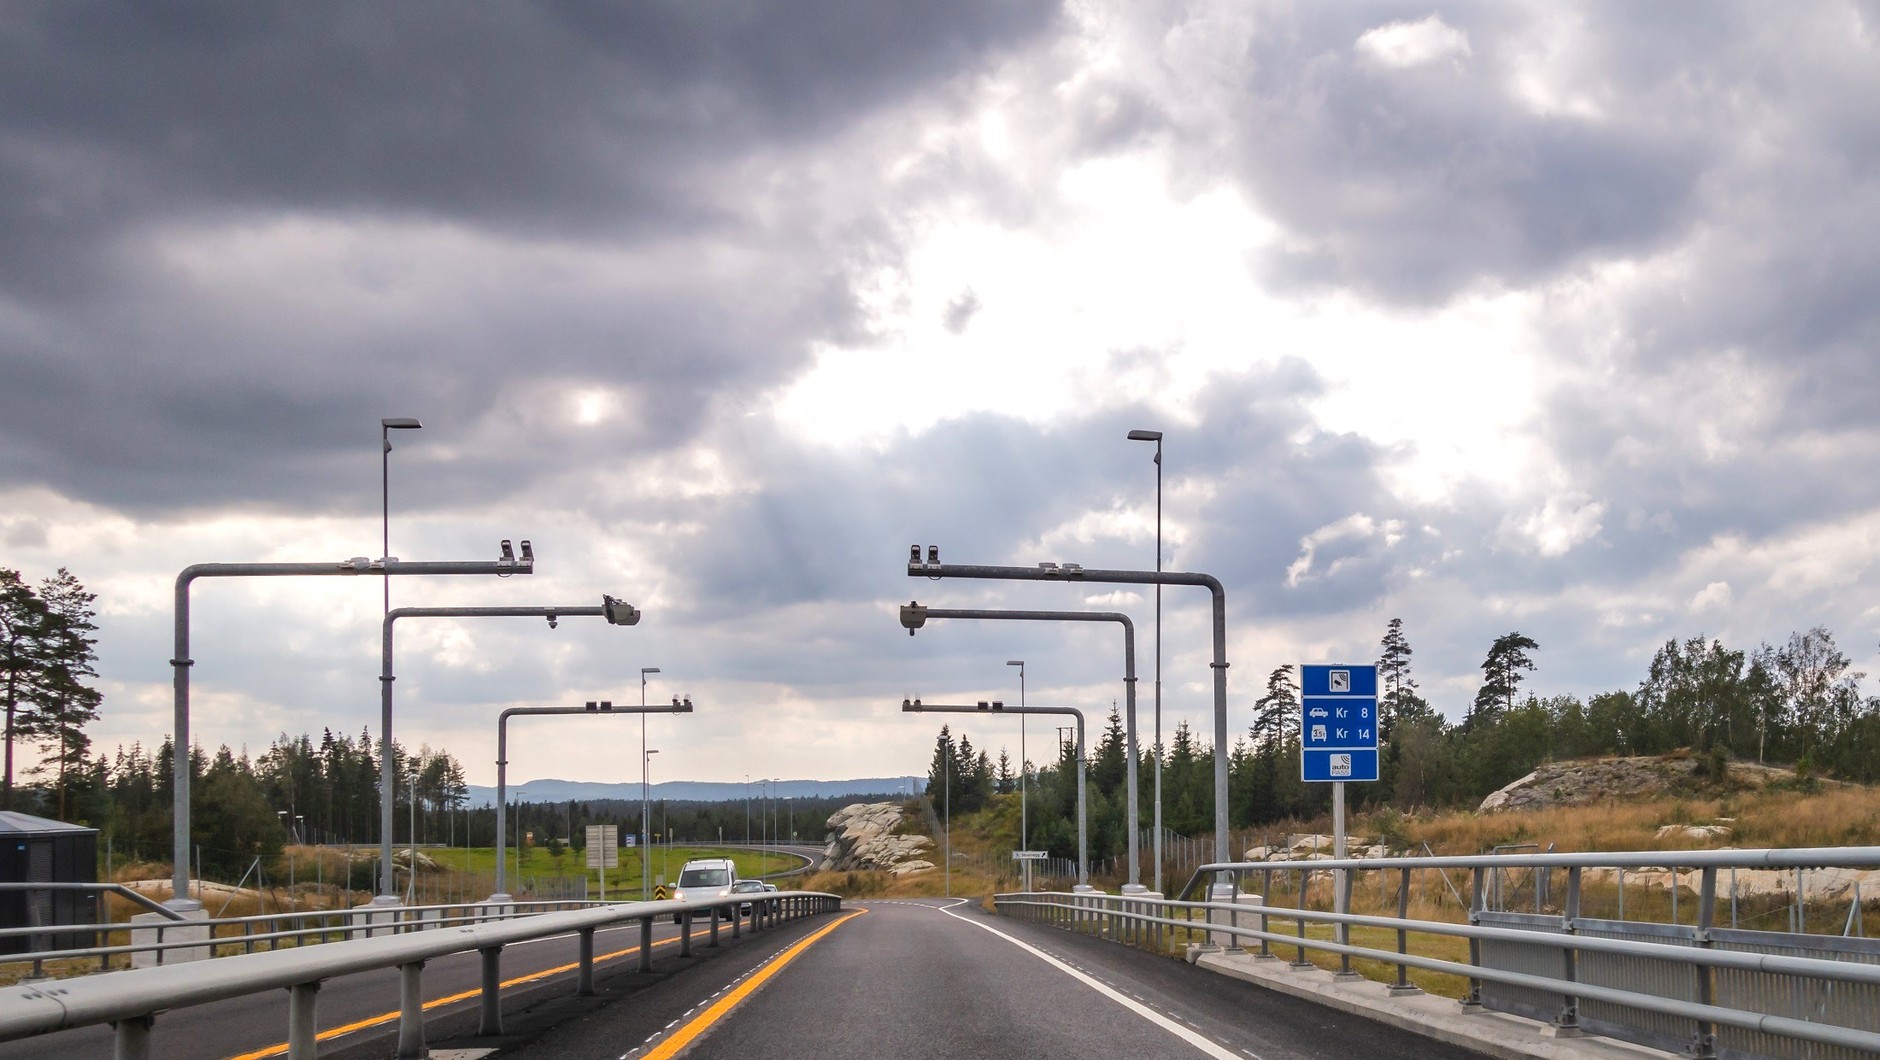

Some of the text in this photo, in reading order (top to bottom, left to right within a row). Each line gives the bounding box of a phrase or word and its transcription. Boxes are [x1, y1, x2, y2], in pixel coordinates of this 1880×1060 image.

[1336, 707, 1368, 718] Kr 8
[1336, 728, 1349, 738] Kr
[1358, 729, 1370, 739] 14
